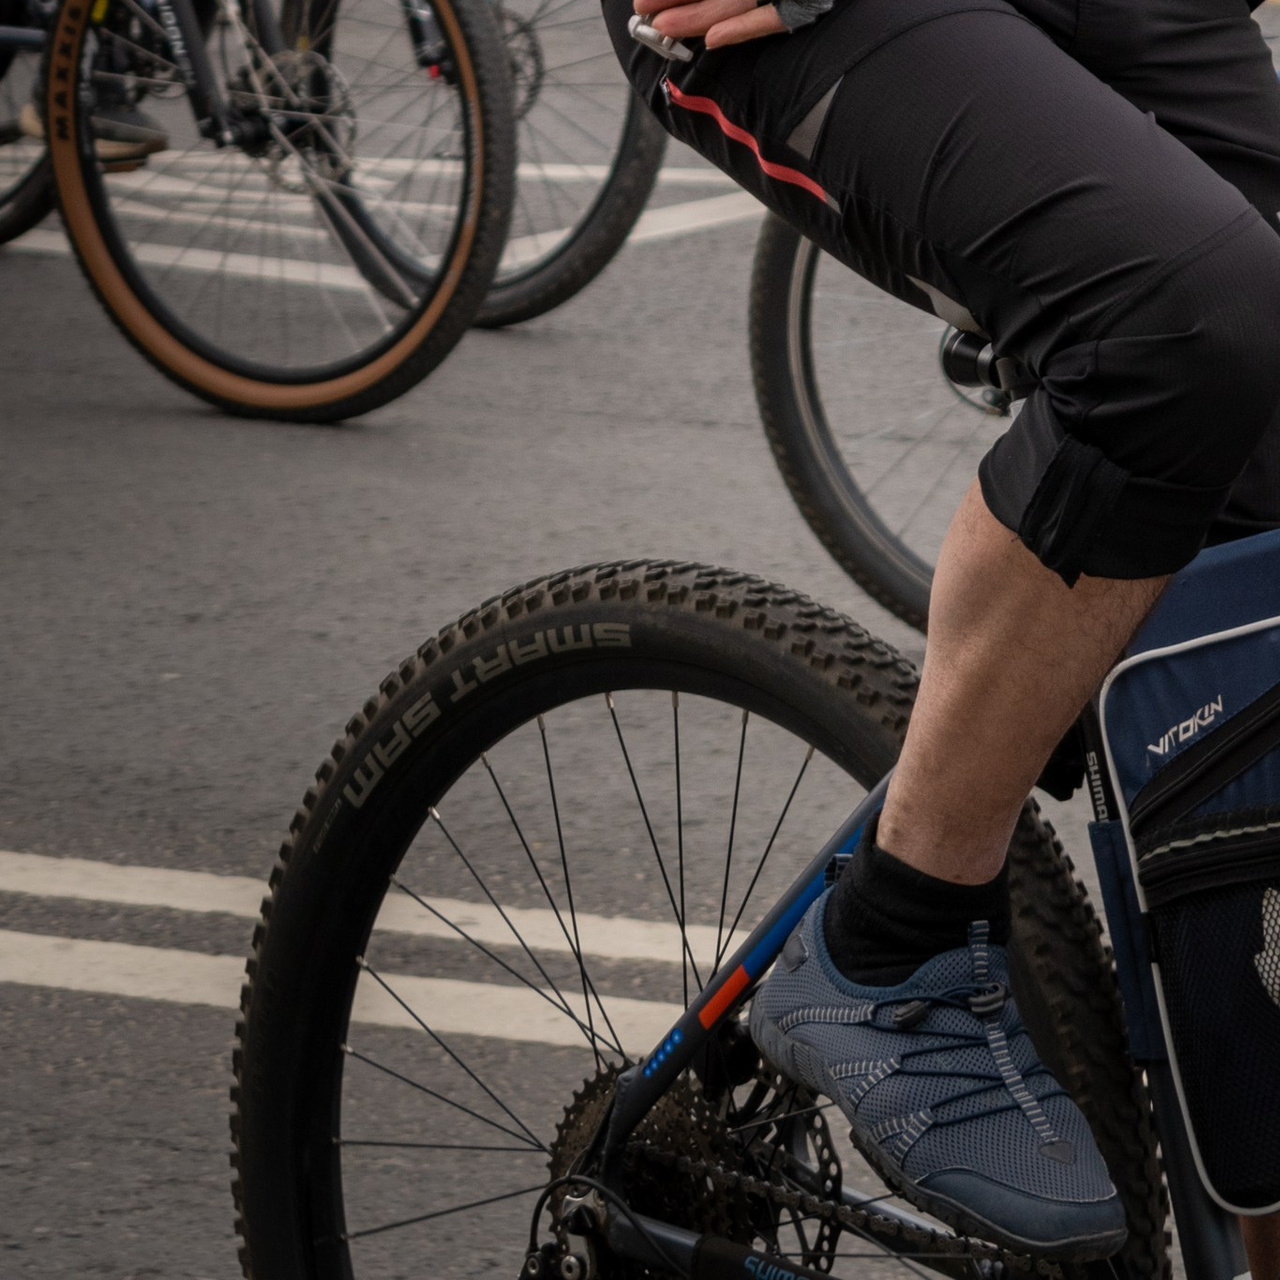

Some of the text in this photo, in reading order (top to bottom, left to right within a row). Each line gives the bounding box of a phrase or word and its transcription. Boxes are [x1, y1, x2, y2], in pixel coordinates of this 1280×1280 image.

[55, 6, 81, 141] MAXXIS
[342, 623, 632, 809] SMART SAM
[1146, 694, 1223, 755] VITOKIN
[1085, 751, 1109, 822] SHIMA
